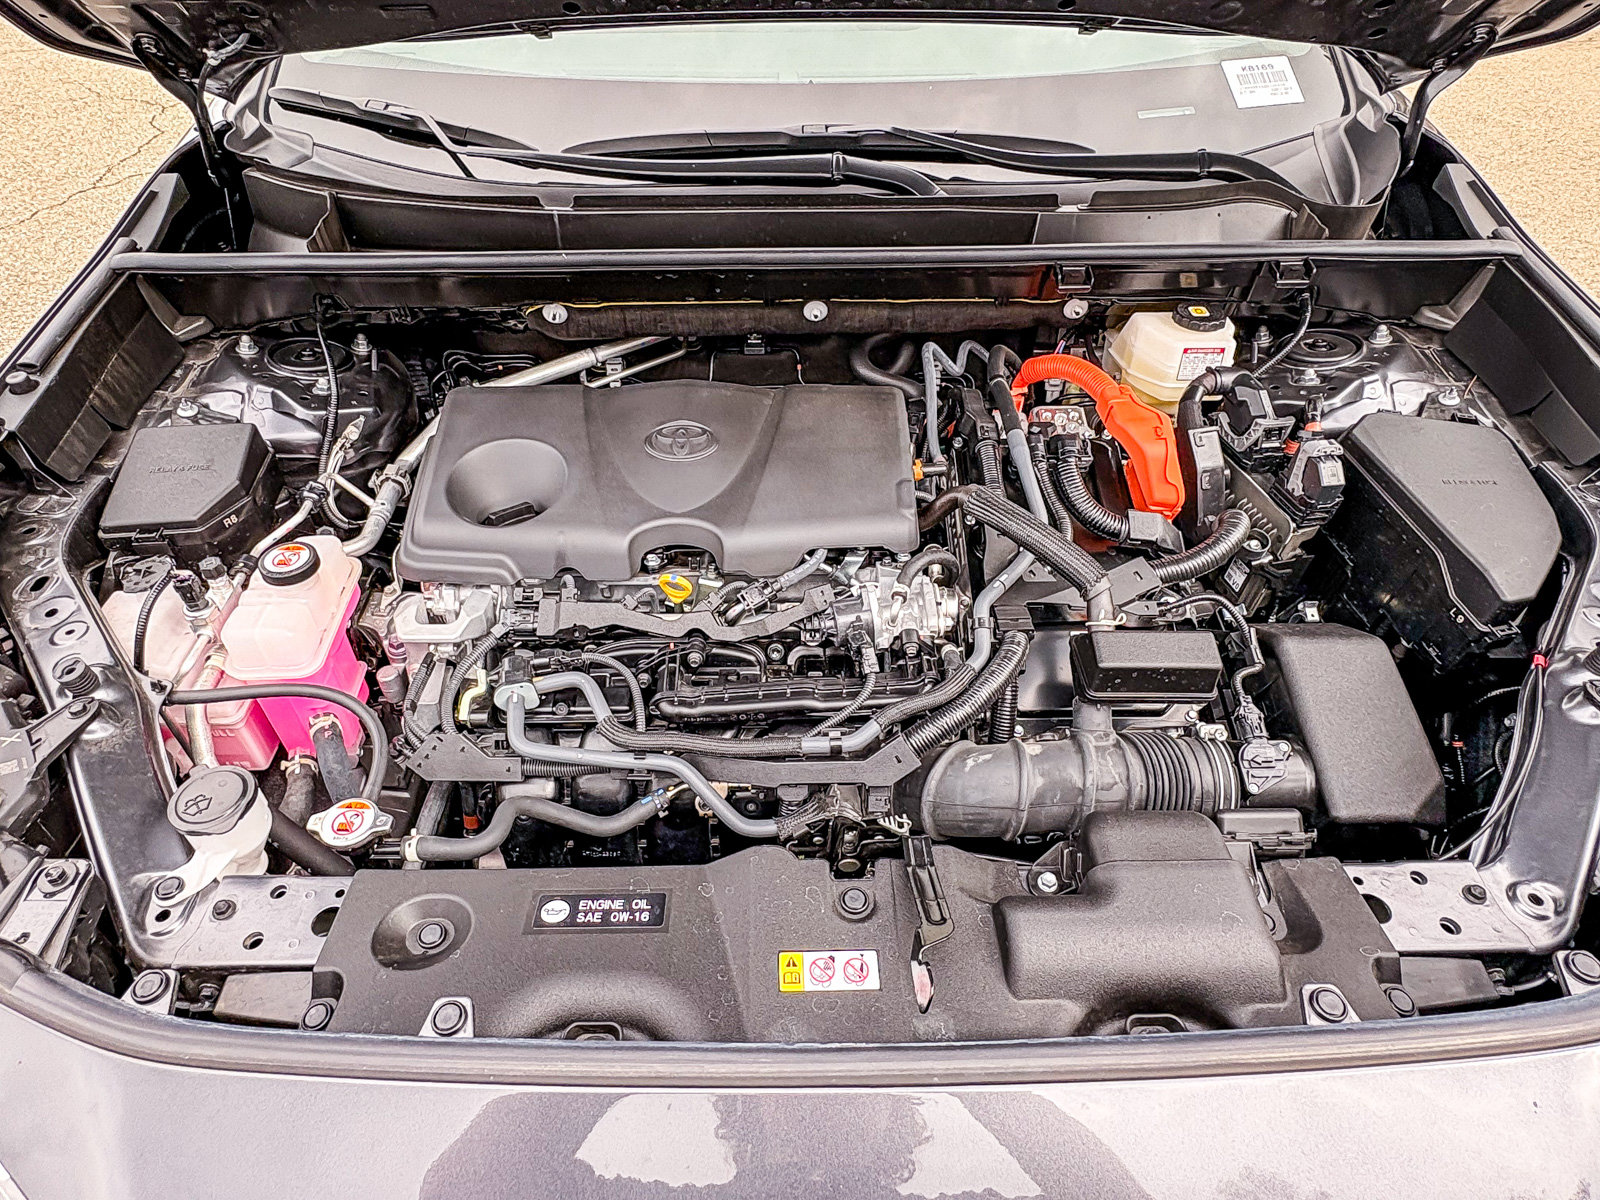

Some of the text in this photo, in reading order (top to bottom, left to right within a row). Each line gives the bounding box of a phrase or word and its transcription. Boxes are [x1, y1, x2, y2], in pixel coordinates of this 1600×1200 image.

[223, 514, 238, 529] R8
[578, 899, 652, 910] ENGINE OIL
[576, 911, 650, 922] SAE 0W-16
